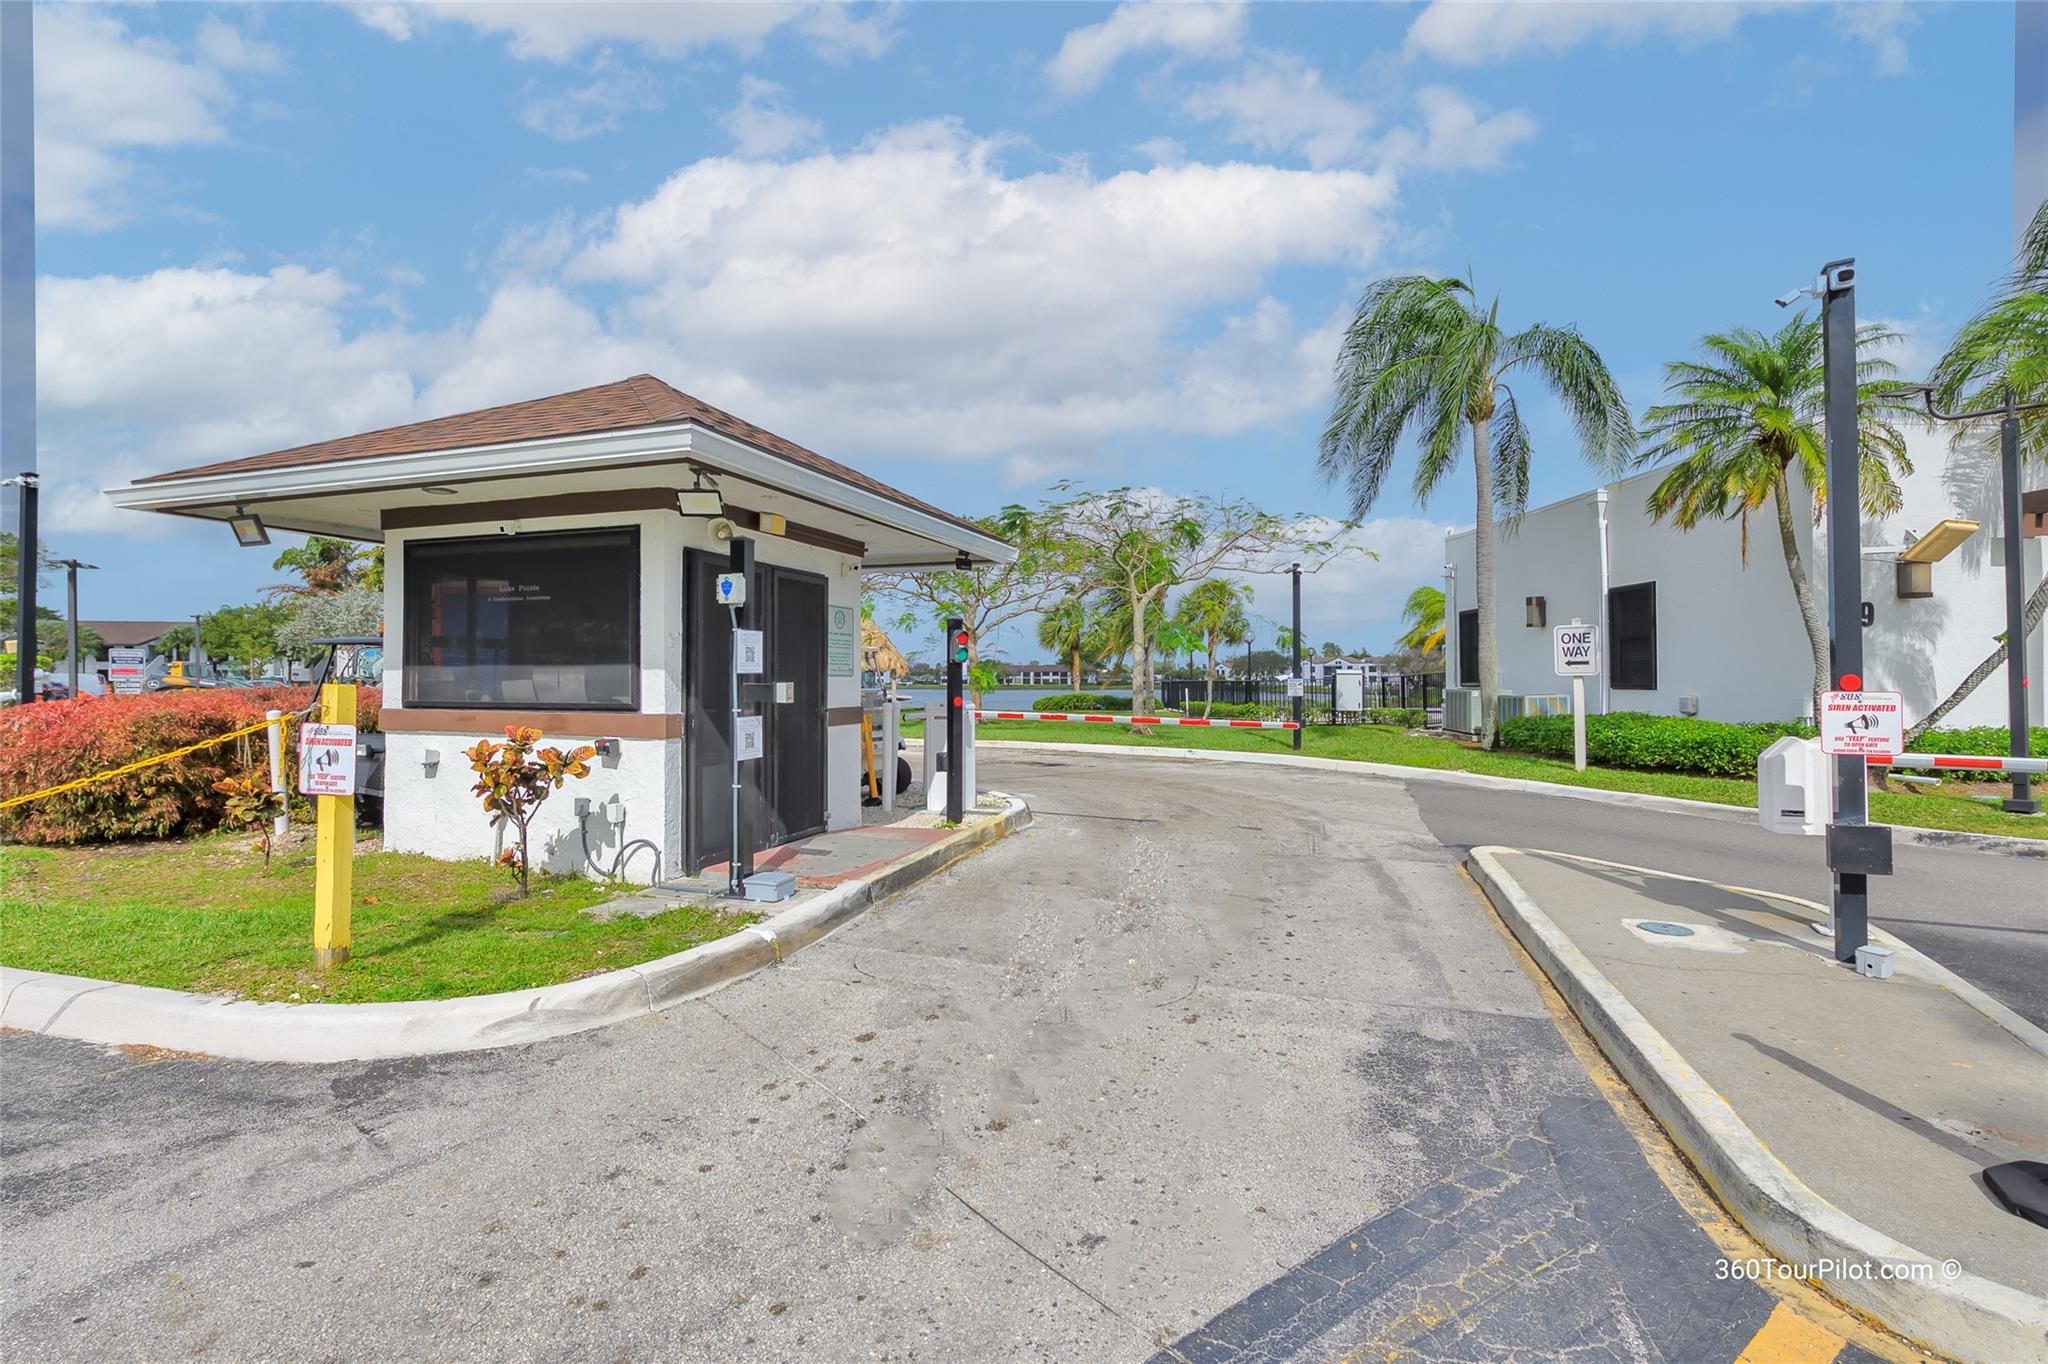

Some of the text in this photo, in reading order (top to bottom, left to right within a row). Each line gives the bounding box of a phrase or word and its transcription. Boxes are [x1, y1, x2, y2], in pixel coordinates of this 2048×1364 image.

[1561, 632, 1591, 644] ONE
[1562, 646, 1590, 657] WAY
[1852, 704, 1896, 712] ACTIVATED
